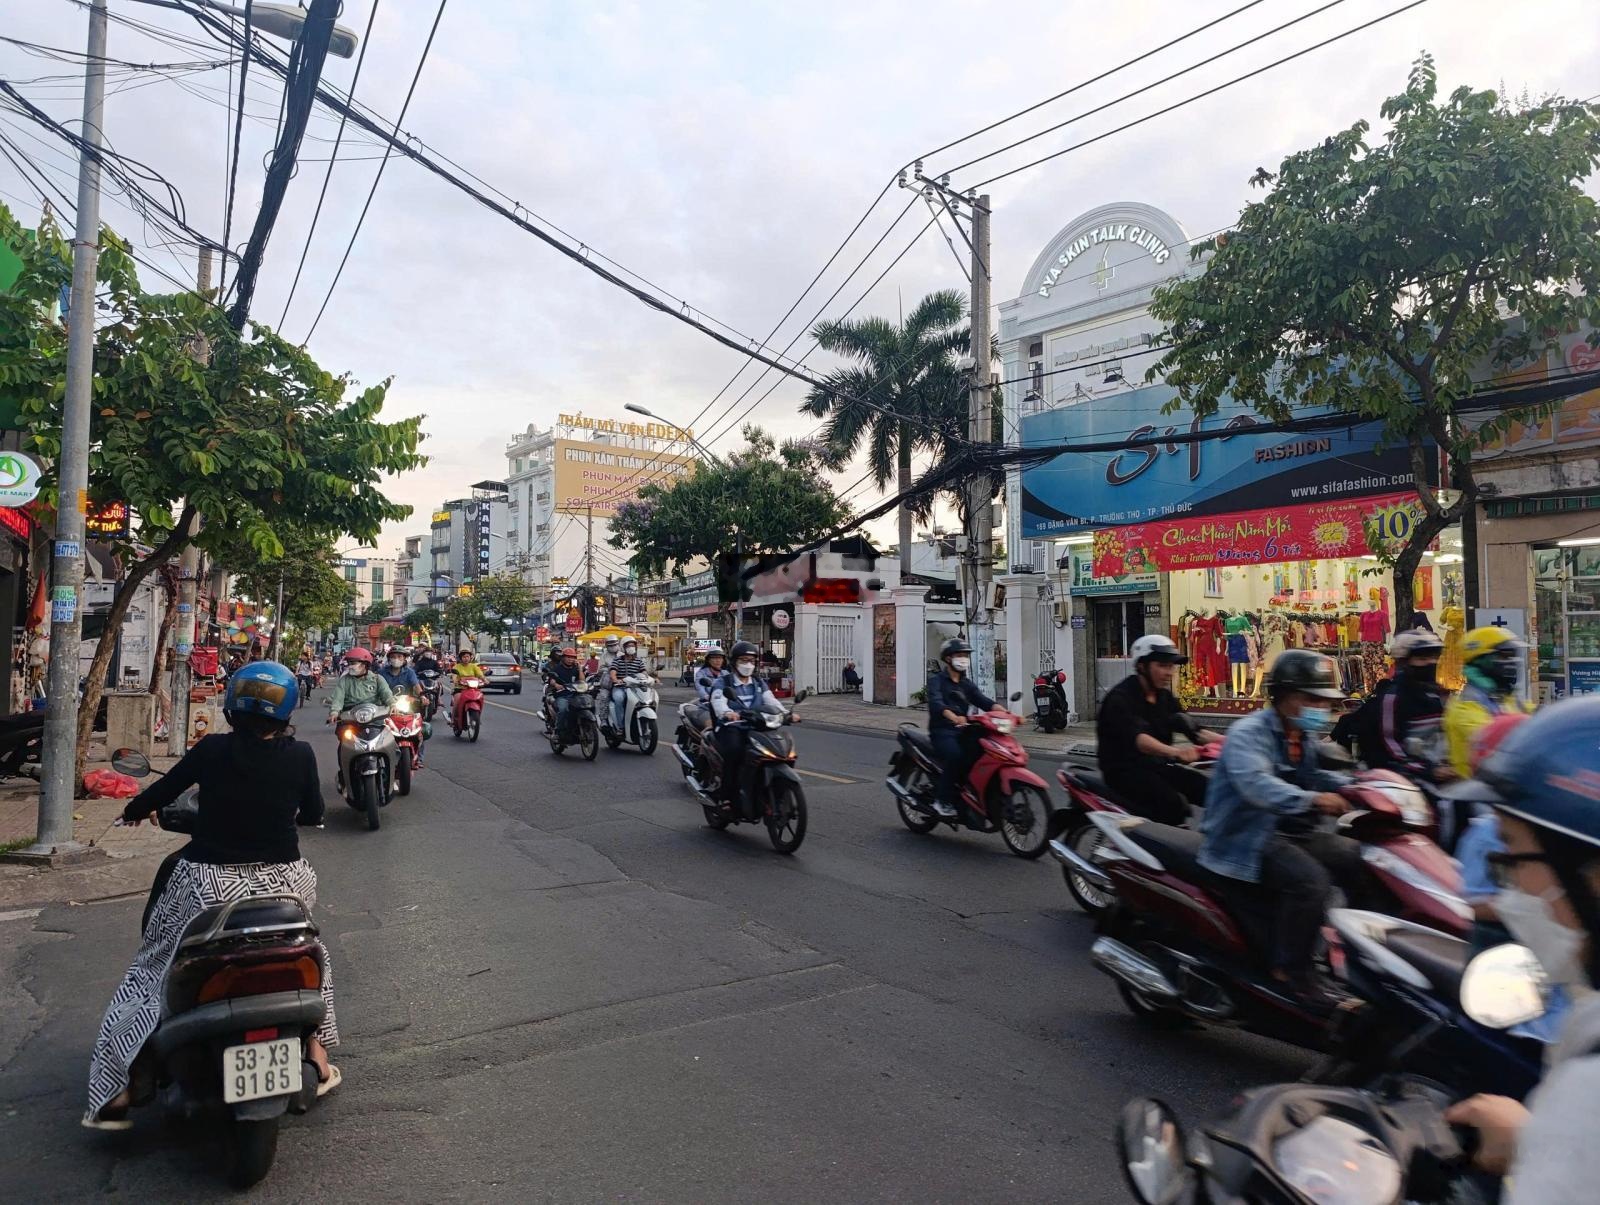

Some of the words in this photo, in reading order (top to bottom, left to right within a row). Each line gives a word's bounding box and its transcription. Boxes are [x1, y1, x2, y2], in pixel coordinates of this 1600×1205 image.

[1039, 268, 1062, 297] PYA
[1058, 236, 1090, 267] SKIN
[1091, 224, 1128, 244] TALK
[1129, 226, 1170, 264] CLINIC
[559, 410, 594, 429] THẨM
[597, 418, 616, 432] MỸ
[619, 421, 645, 436] VIỆN
[565, 448, 592, 462] PHUN
[1255, 437, 1331, 463] FASHION
[583, 470, 611, 481] PHUN
[583, 485, 612, 497] PHUN
[1162, 527, 1202, 547] Chúc
[1235, 519, 1265, 541] Năm
[1266, 514, 1292, 538] Mới
[1170, 554, 1187, 564] Khai
[1264, 535, 1279, 559] 6
[1146, 605, 1159, 614] 169
[235, 1044, 290, 1072] 53-X3
[235, 1067, 291, 1098] 9185
